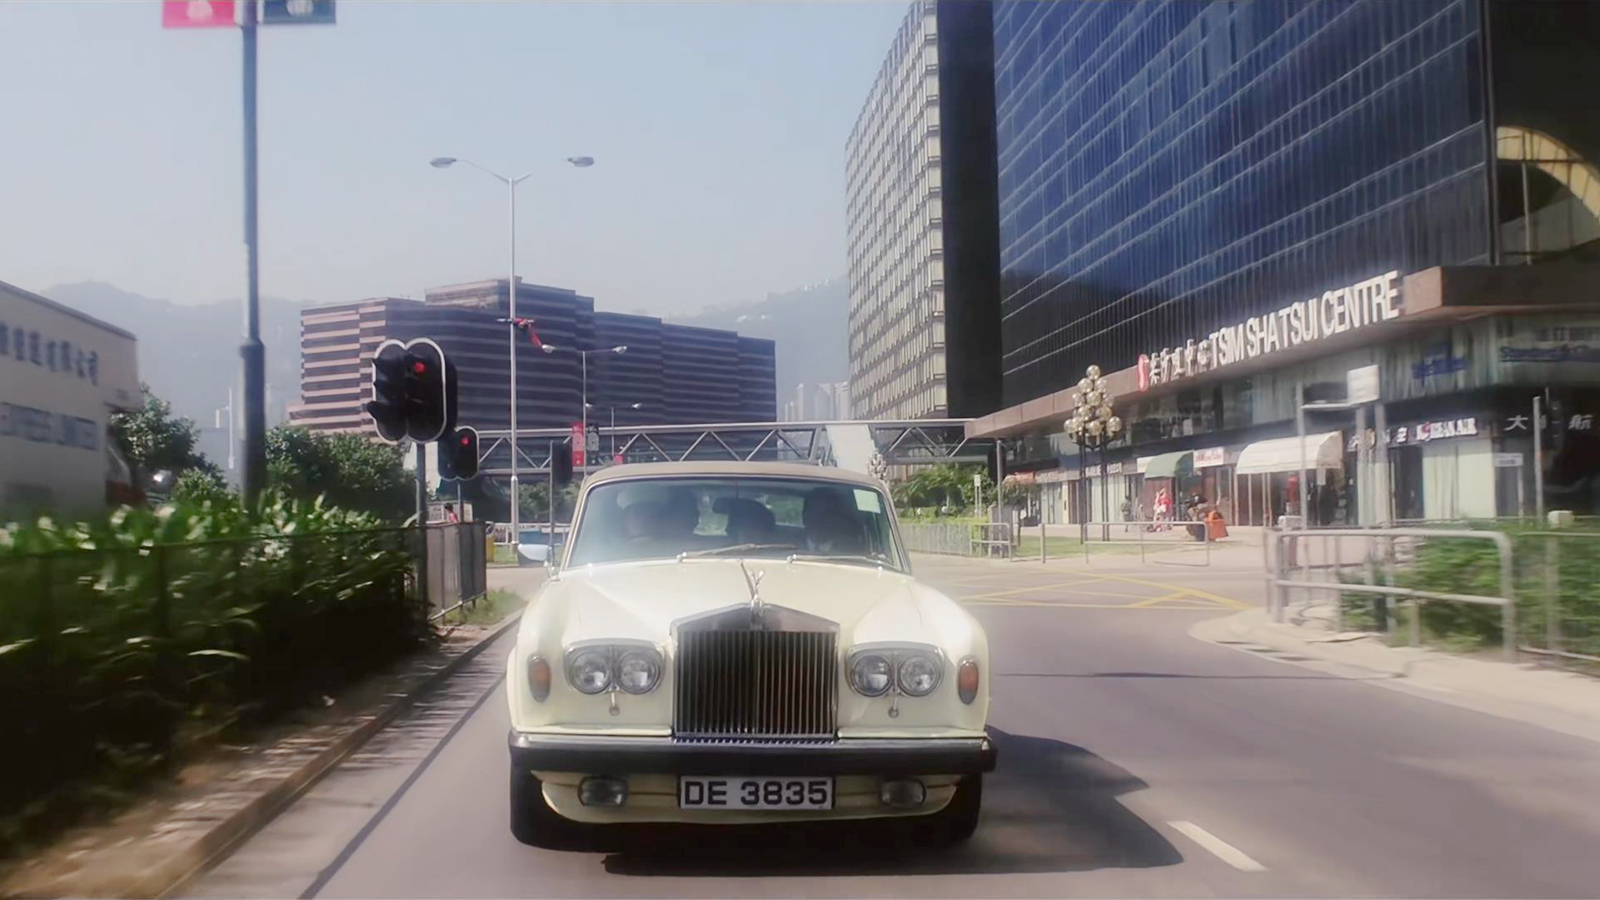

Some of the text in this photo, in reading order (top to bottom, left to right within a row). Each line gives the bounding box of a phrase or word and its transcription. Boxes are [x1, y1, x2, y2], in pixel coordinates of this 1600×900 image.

[1209, 270, 1399, 369] TSIM SHA TSUI CENTRE
[685, 781, 828, 805] DE 3835
